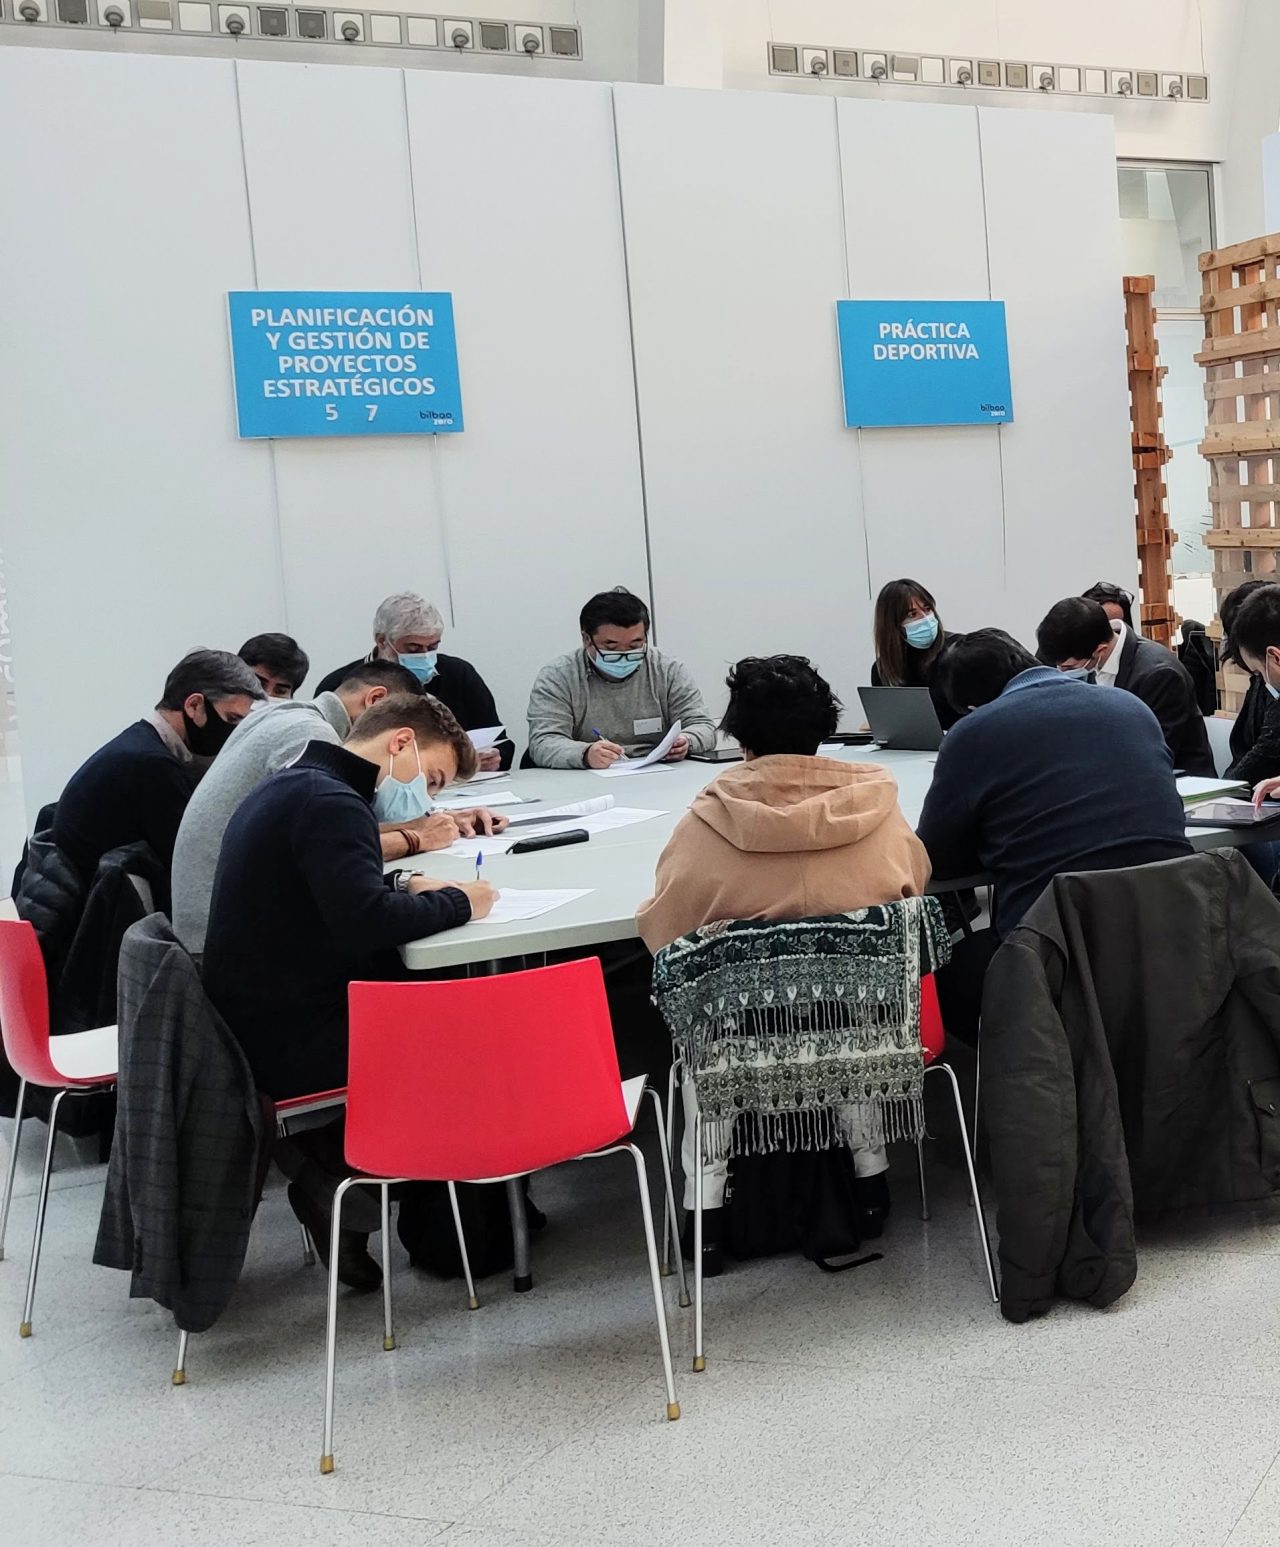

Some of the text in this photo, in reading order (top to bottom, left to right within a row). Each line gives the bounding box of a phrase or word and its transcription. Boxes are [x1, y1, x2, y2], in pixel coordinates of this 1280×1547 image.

[251, 304, 434, 327] PLANIFICACIÓN
[879, 319, 971, 339] PRÁCTICA
[265, 328, 430, 350] Y GESTIÓN DE
[873, 344, 980, 361] DEPORTIVA
[278, 355, 417, 374] PROYECTOS
[263, 374, 436, 398] ESTRATÉGICOS
[325, 404, 379, 421] 5 7
[419, 410, 453, 420] bilbao
